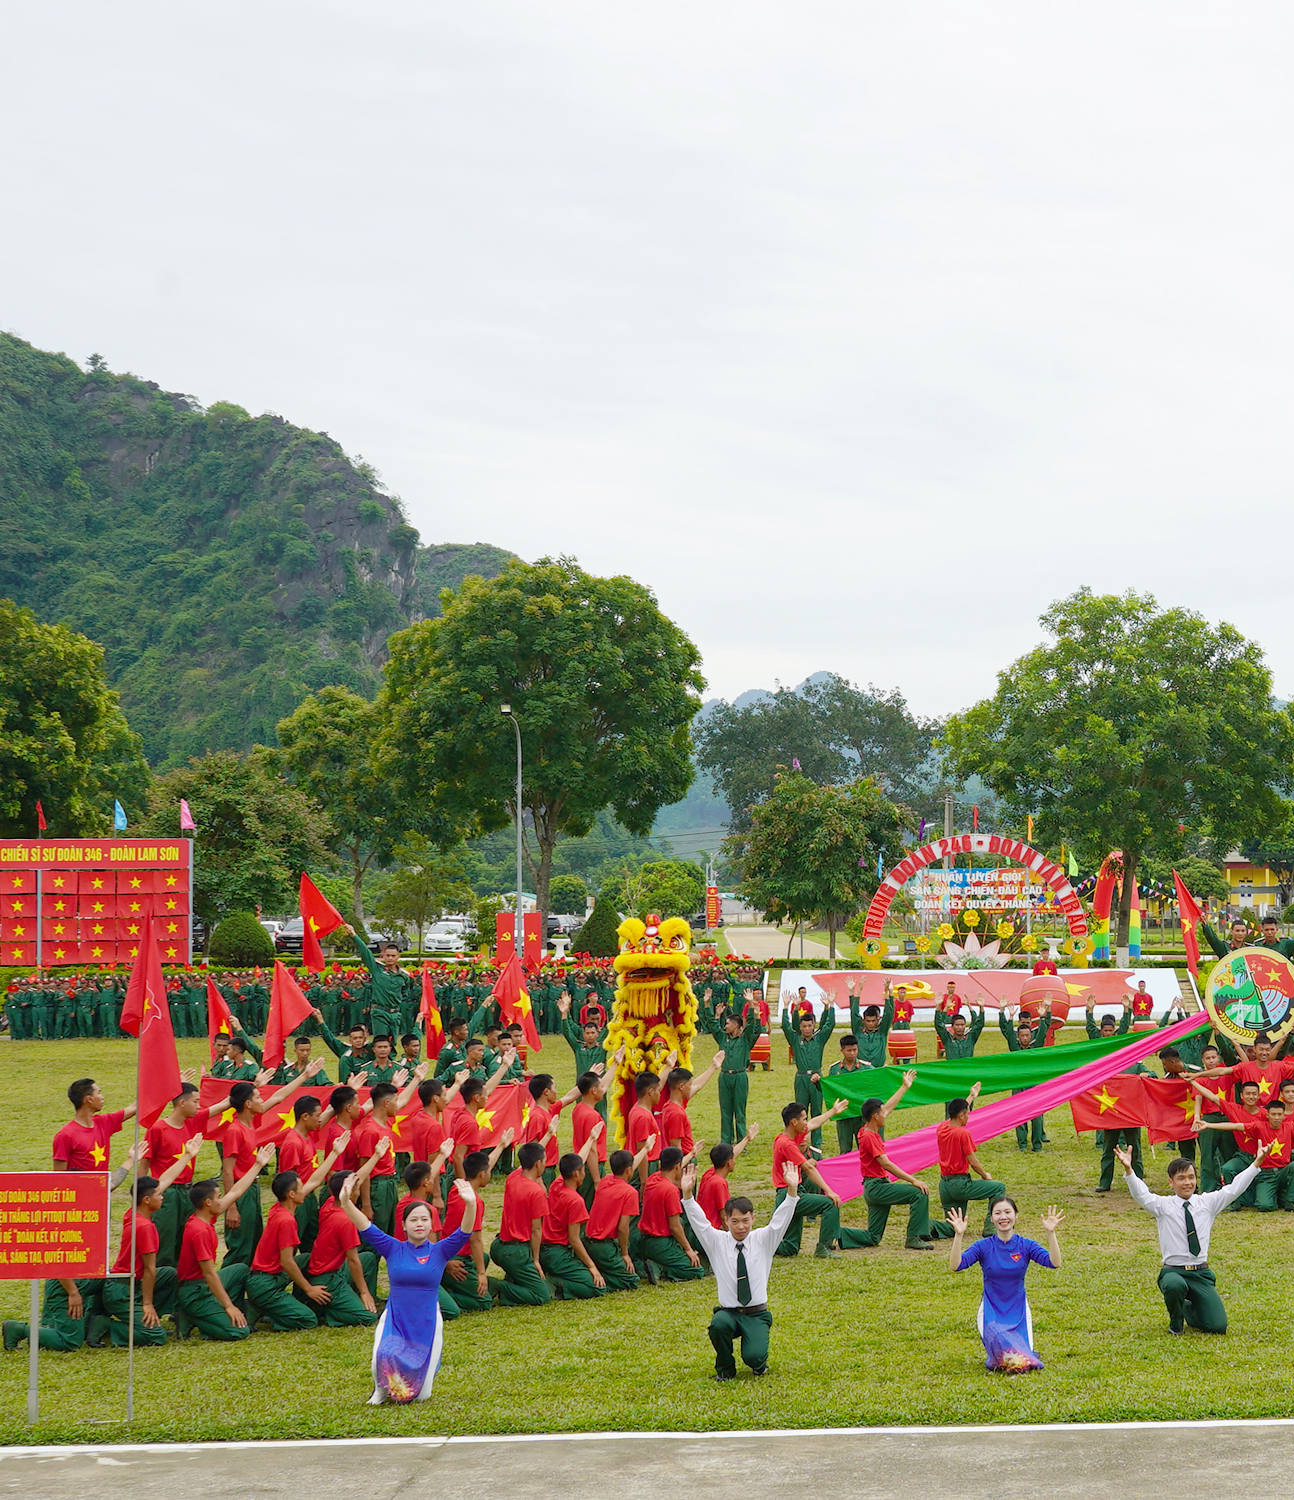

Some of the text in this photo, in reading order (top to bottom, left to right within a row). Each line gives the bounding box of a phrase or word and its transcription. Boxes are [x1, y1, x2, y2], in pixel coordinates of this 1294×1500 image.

[1, 844, 29, 861] CHIẾN
[31, 845, 41, 861] SĨ
[42, 846, 57, 861] SƯ
[57, 845, 83, 861] ĐOÀN
[84, 847, 102, 861] 346
[110, 844, 136, 861] ĐOÀN
[137, 847, 158, 861] LAM
[159, 845, 179, 861] SƠN
[862, 883, 898, 938] TRUNG
[890, 844, 937, 886] ĐOÀN
[938, 834, 972, 857] 246
[988, 837, 1038, 868] ĐOÀN
[1022, 886, 1043, 895] CAO
[28, 1190, 40, 1203] 346
[62, 1188, 76, 1202] TÂM
